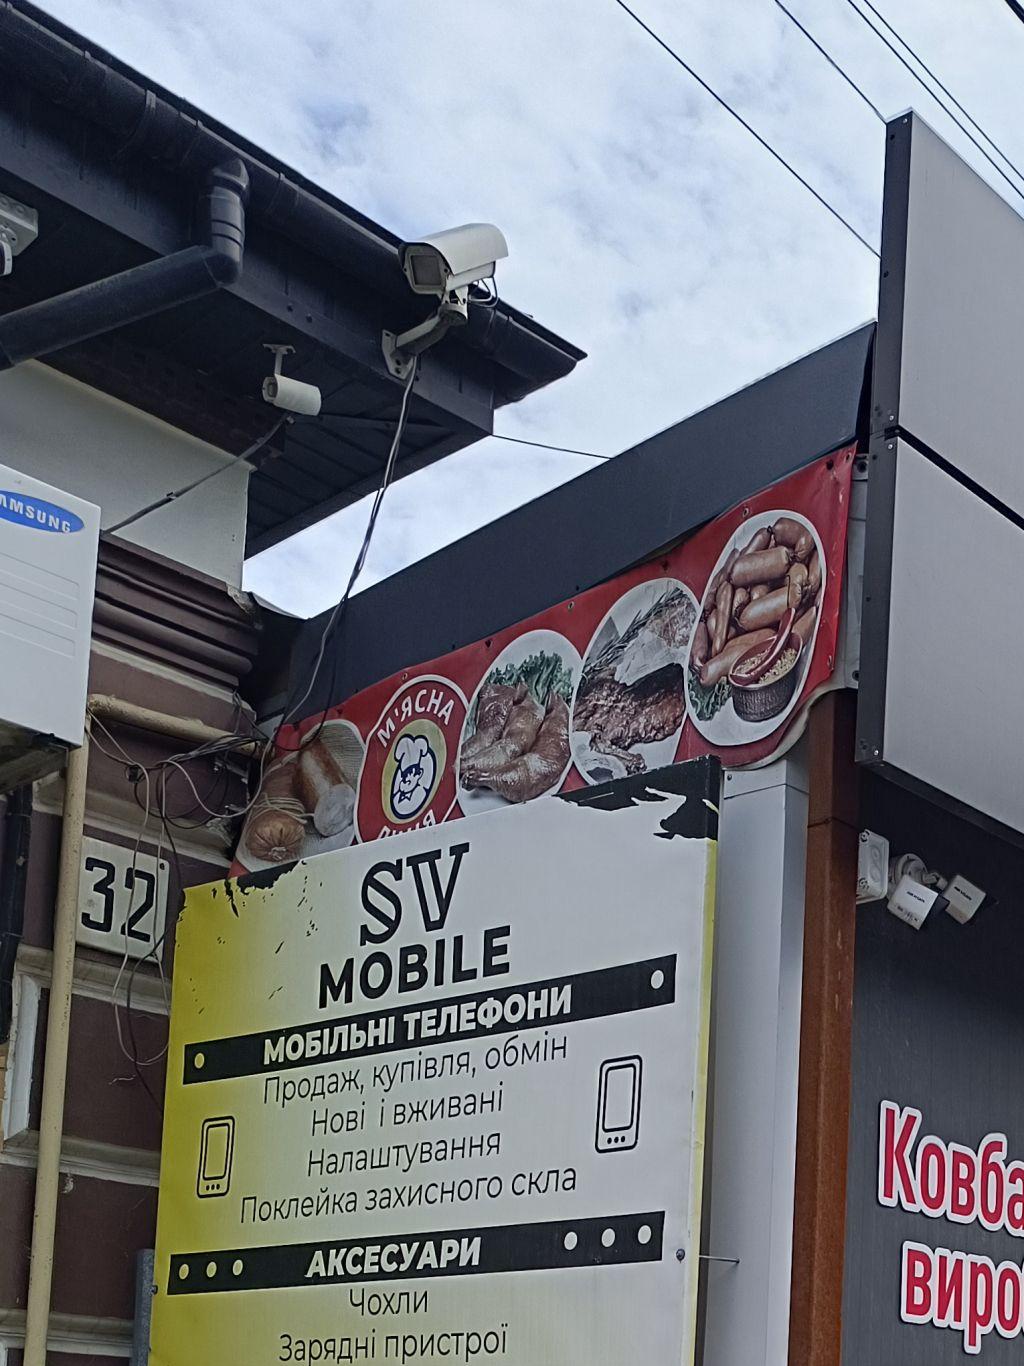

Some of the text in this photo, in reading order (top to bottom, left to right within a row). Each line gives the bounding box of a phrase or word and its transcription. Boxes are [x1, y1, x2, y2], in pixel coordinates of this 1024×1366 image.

[0, 493, 71, 534] AMSUNG
[376, 688, 455, 749] М'ЯСНА
[81, 855, 156, 944] 32
[361, 841, 471, 947] SV
[317, 925, 512, 1009] MOBILE
[262, 984, 573, 1066] МОБІЛЬНІ ТЕЛЕФОНИ
[263, 1031, 569, 1108] Продаж, купівля, обмін
[311, 1081, 505, 1137] Нові і вживані
[307, 1131, 502, 1178] Налаштування
[240, 1165, 578, 1224] Поклейка захисного скла
[305, 1237, 482, 1279] АКСЕСУАРИ
[349, 1287, 430, 1318] Чохли
[384, 1323, 509, 1366] пристрої
